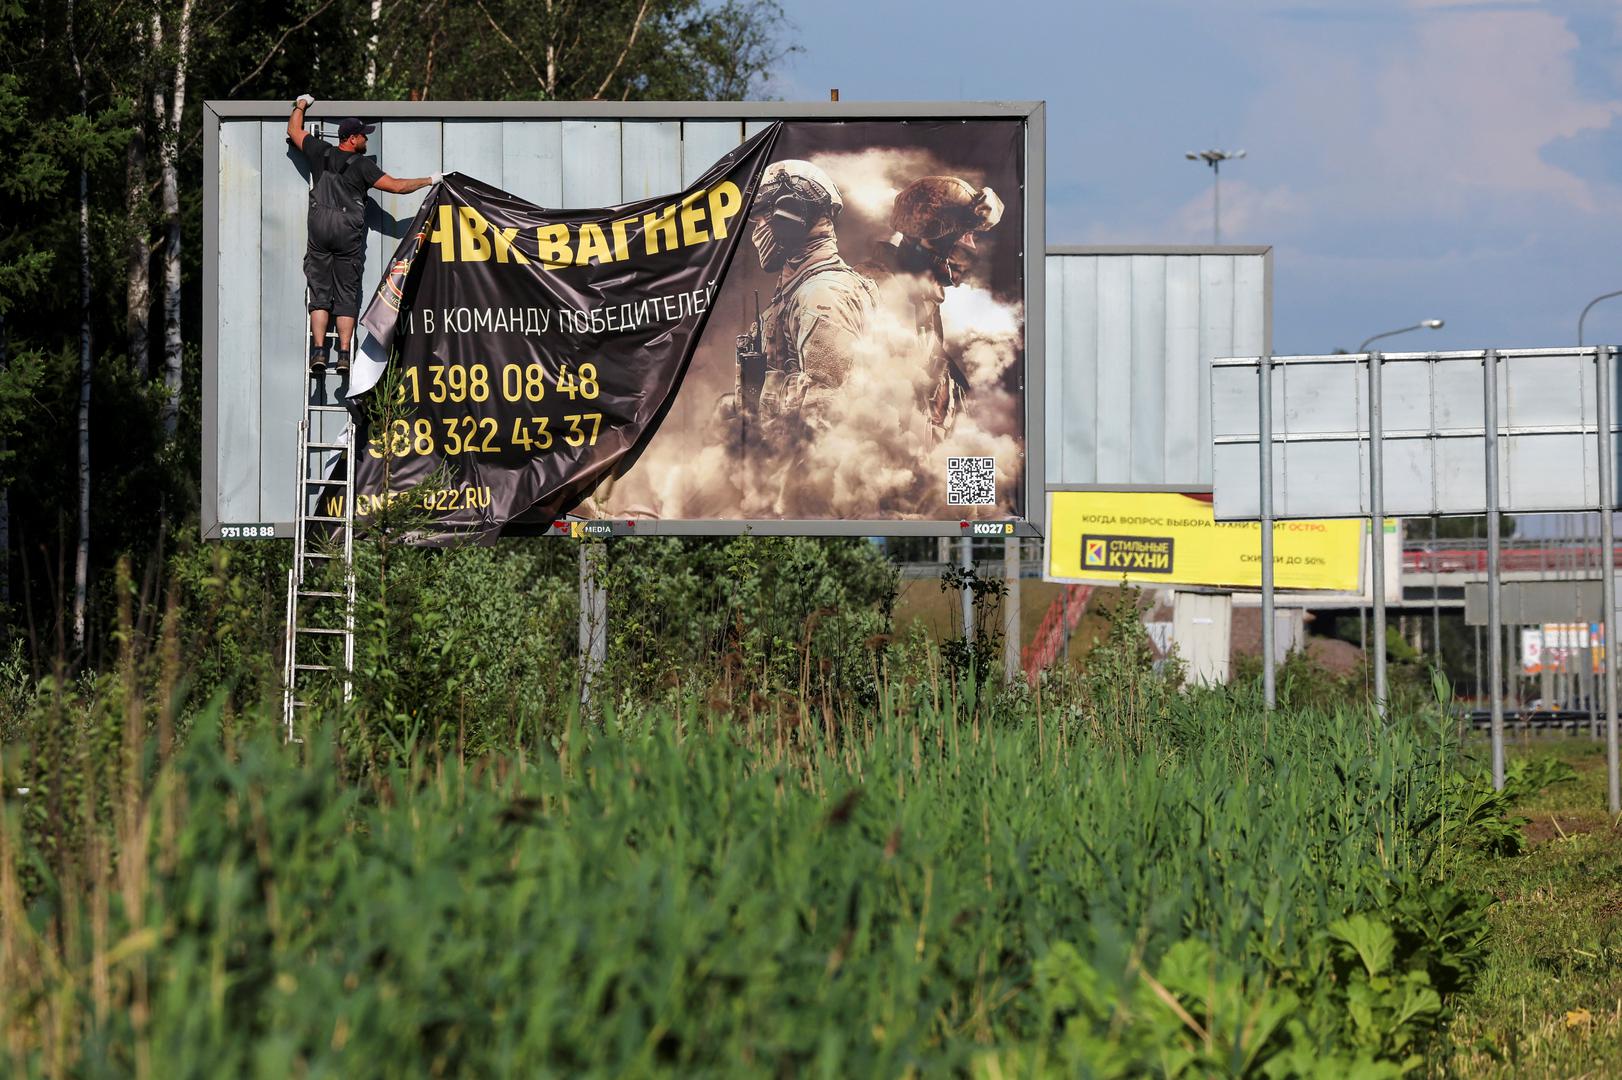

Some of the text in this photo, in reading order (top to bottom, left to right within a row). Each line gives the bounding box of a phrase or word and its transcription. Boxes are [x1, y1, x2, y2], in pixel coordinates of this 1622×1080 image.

[427, 181, 743, 271] ЧВК ВАГНЕР
[423, 309, 435, 335] В
[444, 307, 551, 336] КОМАНДУ
[559, 280, 718, 335] ПОБЕДИТЕЛЕЙ
[429, 363, 490, 404] 398
[502, 362, 545, 402] 08
[556, 362, 600, 401] 48
[443, 415, 501, 456] 322
[511, 416, 553, 451] 43
[563, 412, 602, 447] 37
[221, 526, 274, 538] 931 88 88
[1082, 515, 1116, 525] КОГДА
[1120, 516, 1163, 526] ВОПРОС
[1167, 518, 1211, 528] ВЫБОРА
[1109, 540, 1169, 553] СТИЛЬНЫЕ
[1109, 551, 1169, 569] КУХНИ
